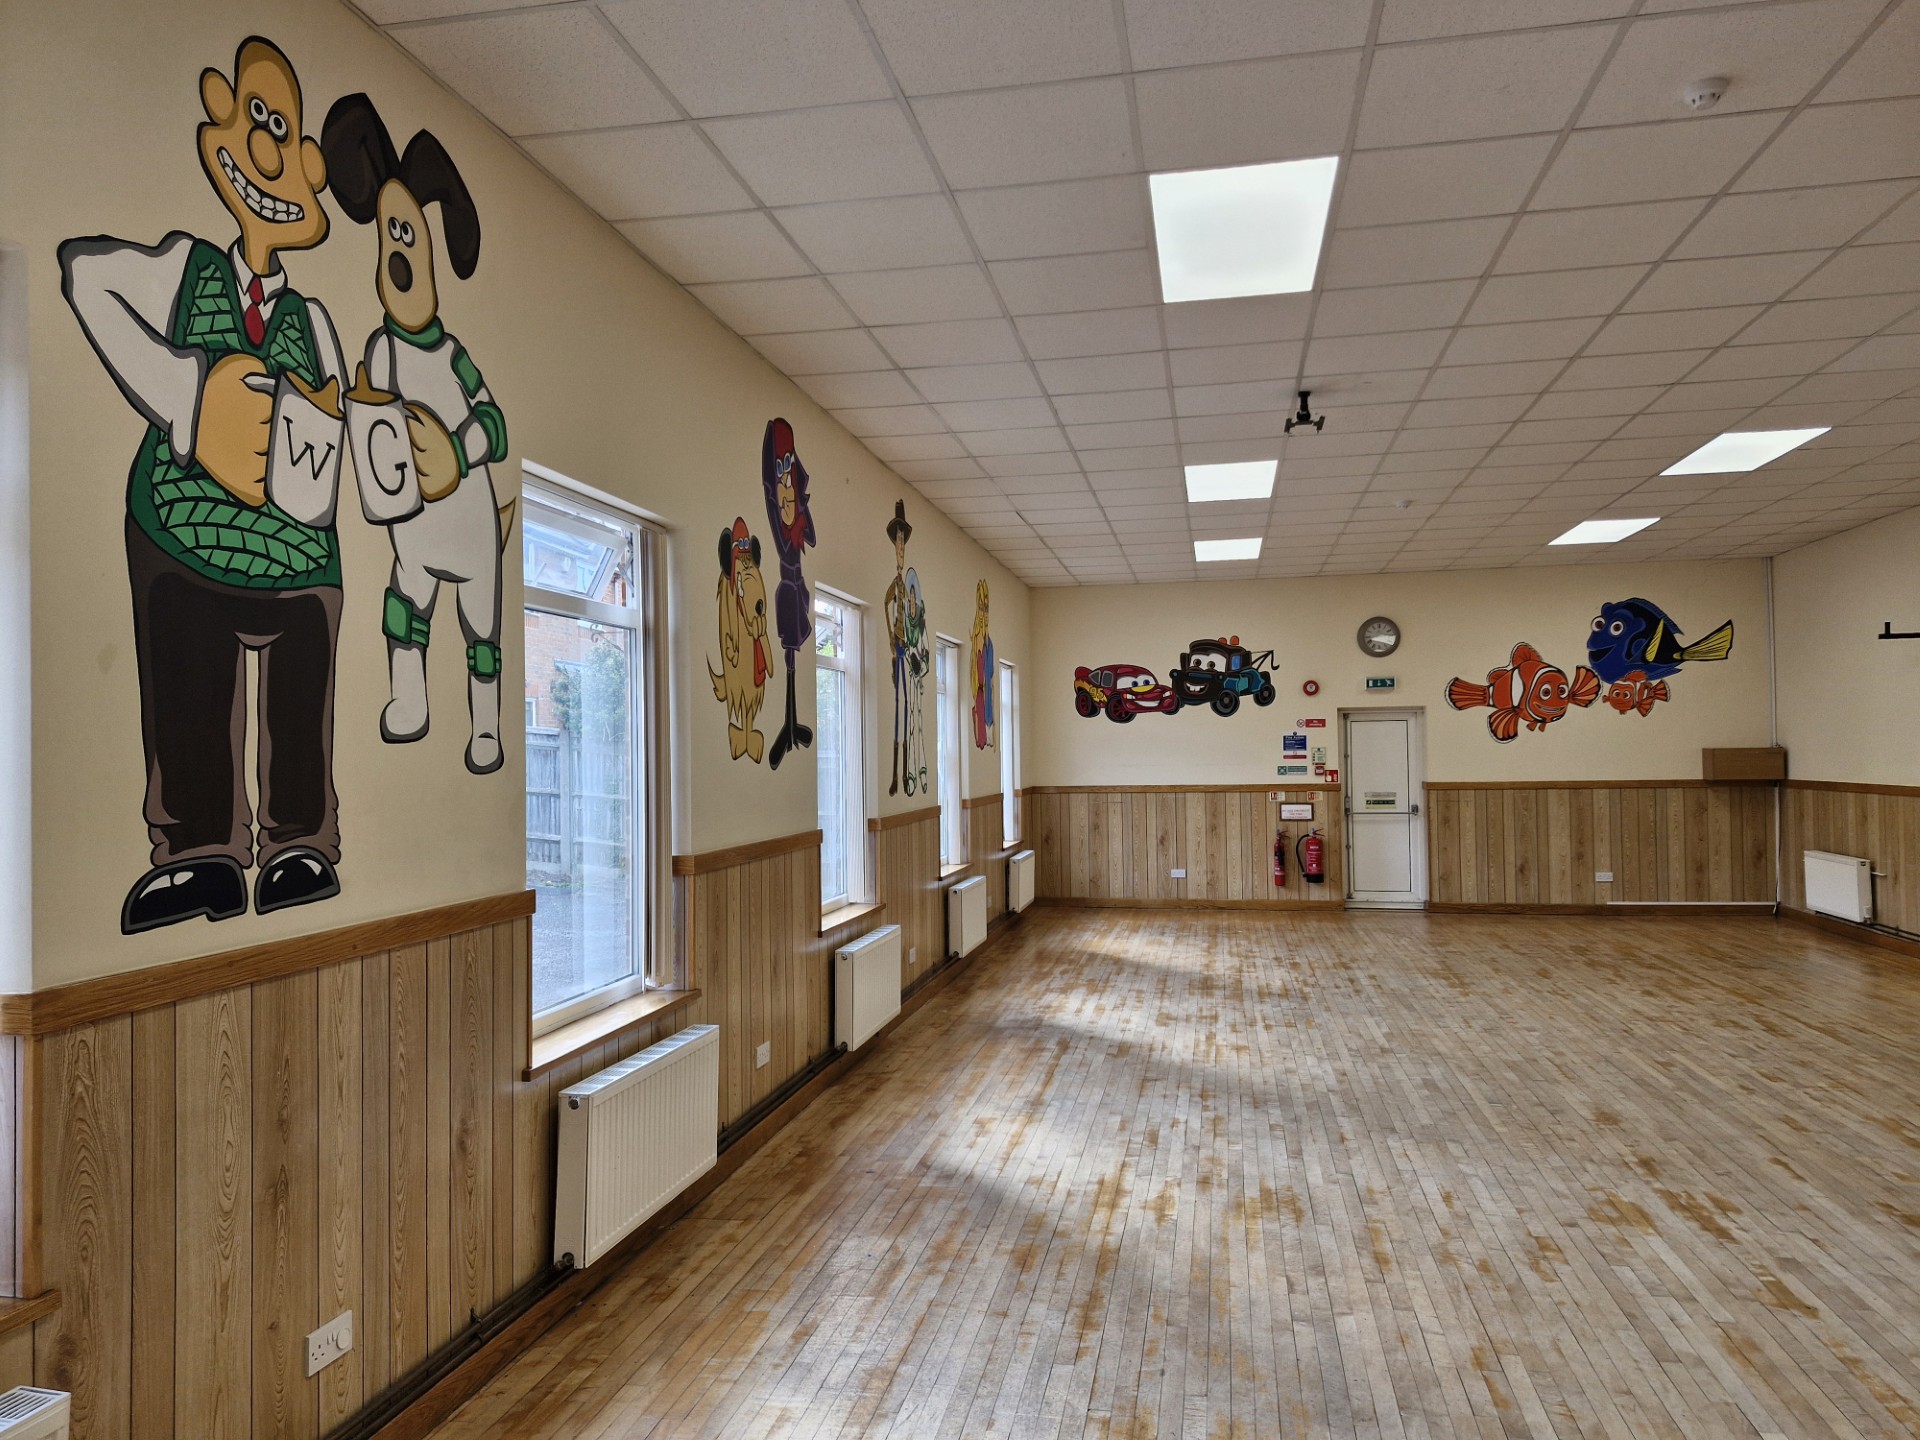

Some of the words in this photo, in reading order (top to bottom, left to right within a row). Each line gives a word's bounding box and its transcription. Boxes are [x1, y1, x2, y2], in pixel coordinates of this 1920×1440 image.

[282, 415, 336, 481] W
[367, 418, 408, 496] G
[1089, 686, 1104, 699] 95
